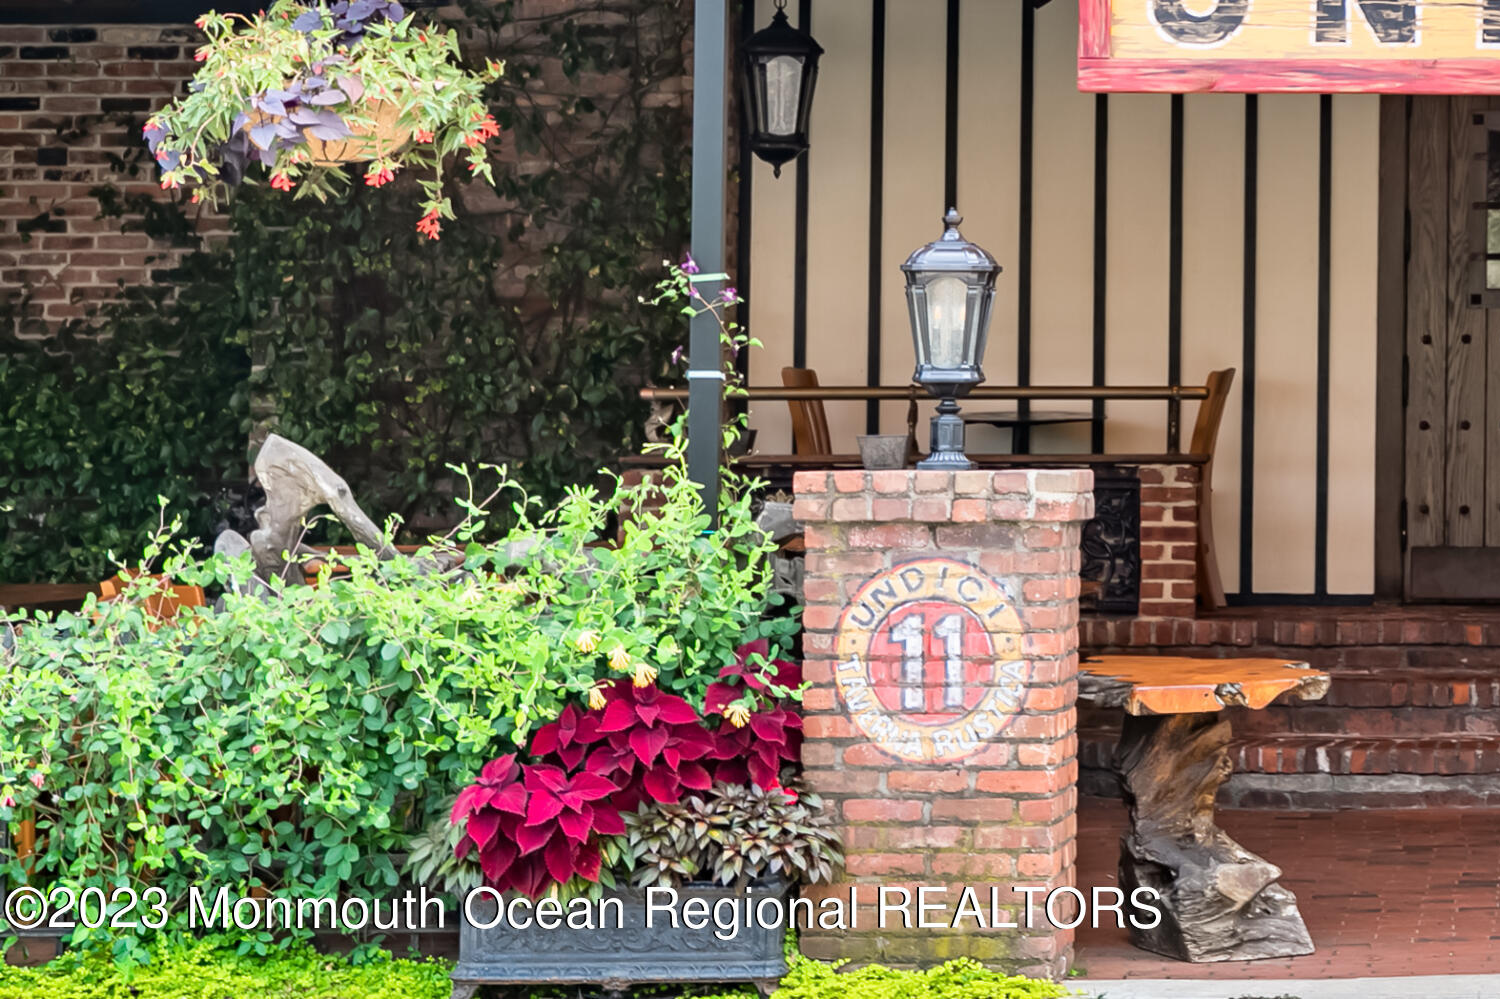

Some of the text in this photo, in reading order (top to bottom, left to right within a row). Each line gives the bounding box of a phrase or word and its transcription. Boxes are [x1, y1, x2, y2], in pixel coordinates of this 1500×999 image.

[850, 565, 1005, 629] UNDICI
[837, 652, 924, 758] TAVERNA
[887, 612, 968, 713] 11
